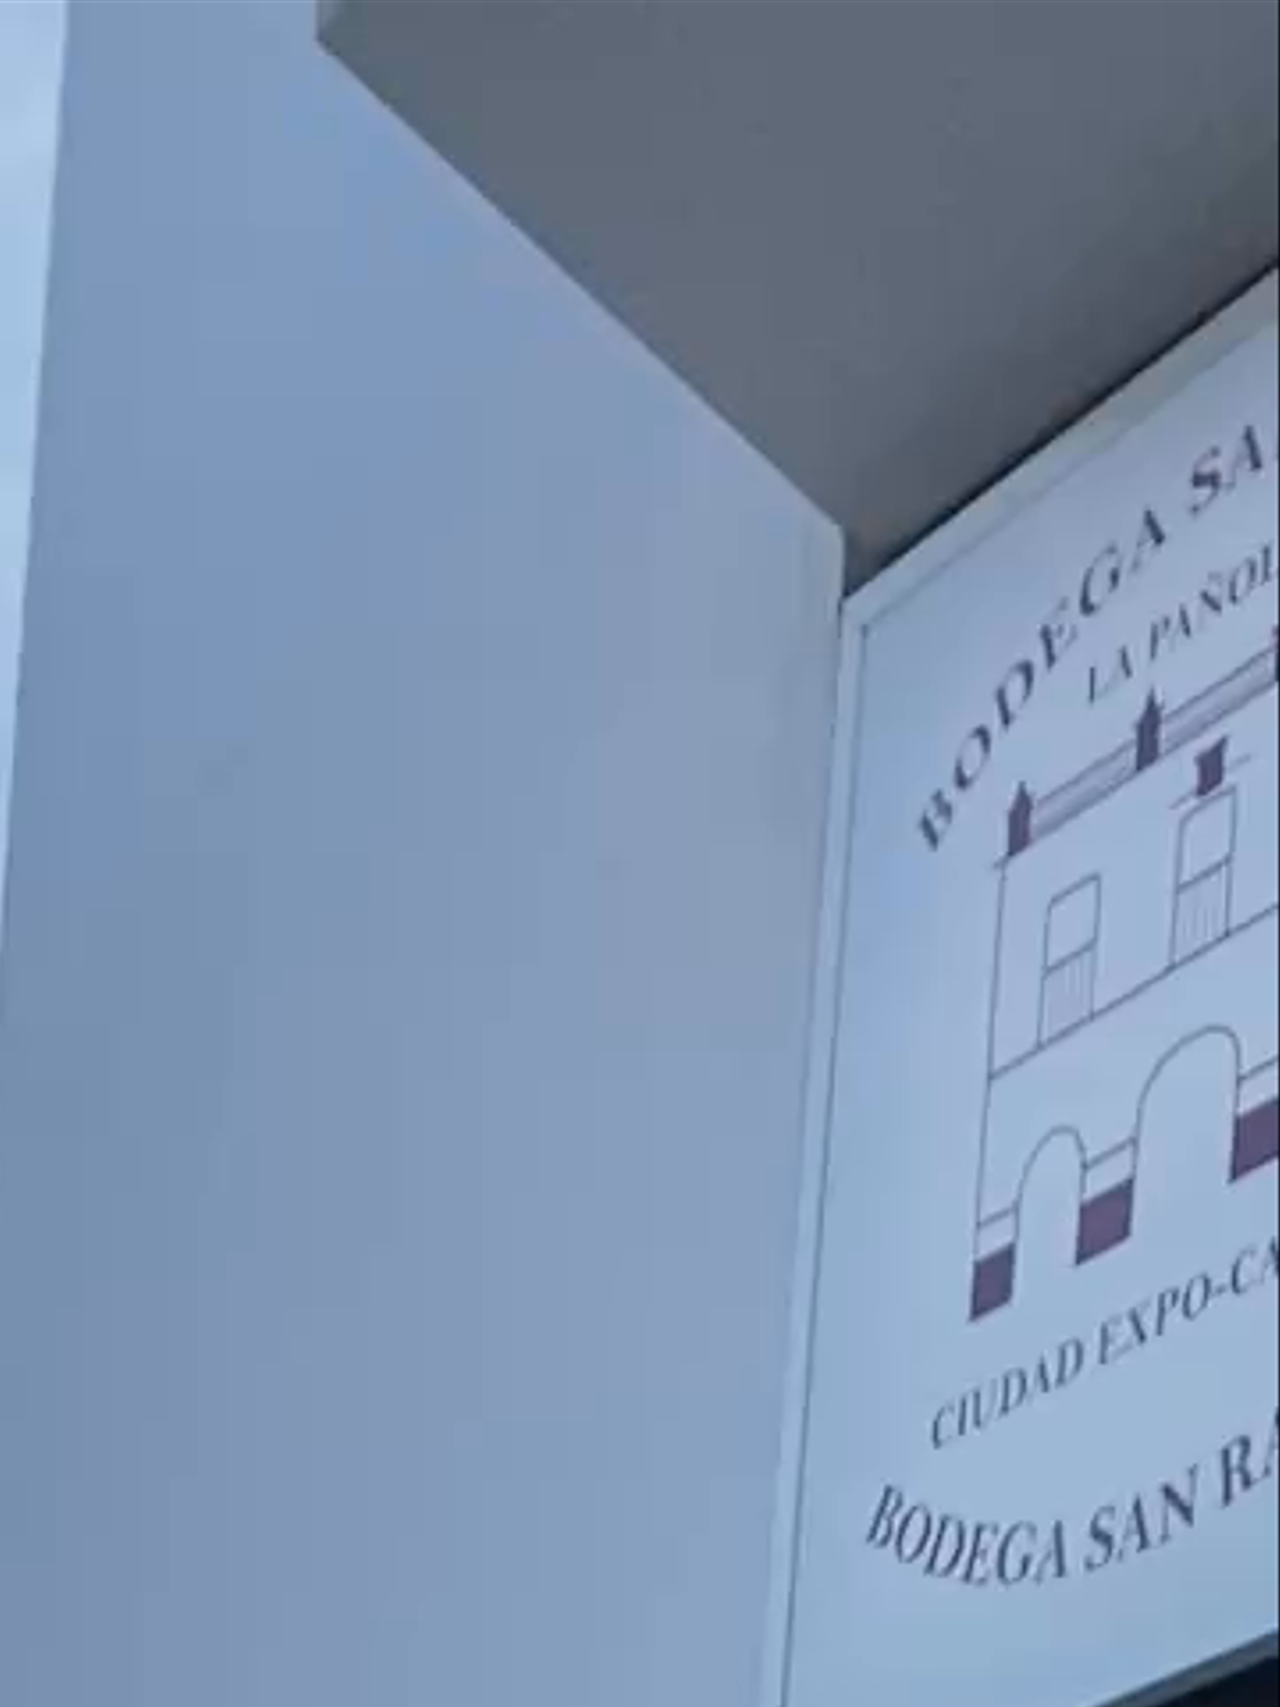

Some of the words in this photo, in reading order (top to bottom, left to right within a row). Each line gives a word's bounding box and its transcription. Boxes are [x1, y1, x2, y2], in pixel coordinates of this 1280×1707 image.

[918, 508, 1167, 852] BODEGA
[1088, 645, 1135, 705] LA
[930, 1337, 1085, 1450] CIUDAD
[865, 1484, 1069, 1588] BODEGA
[1083, 1463, 1198, 1573] SAN
